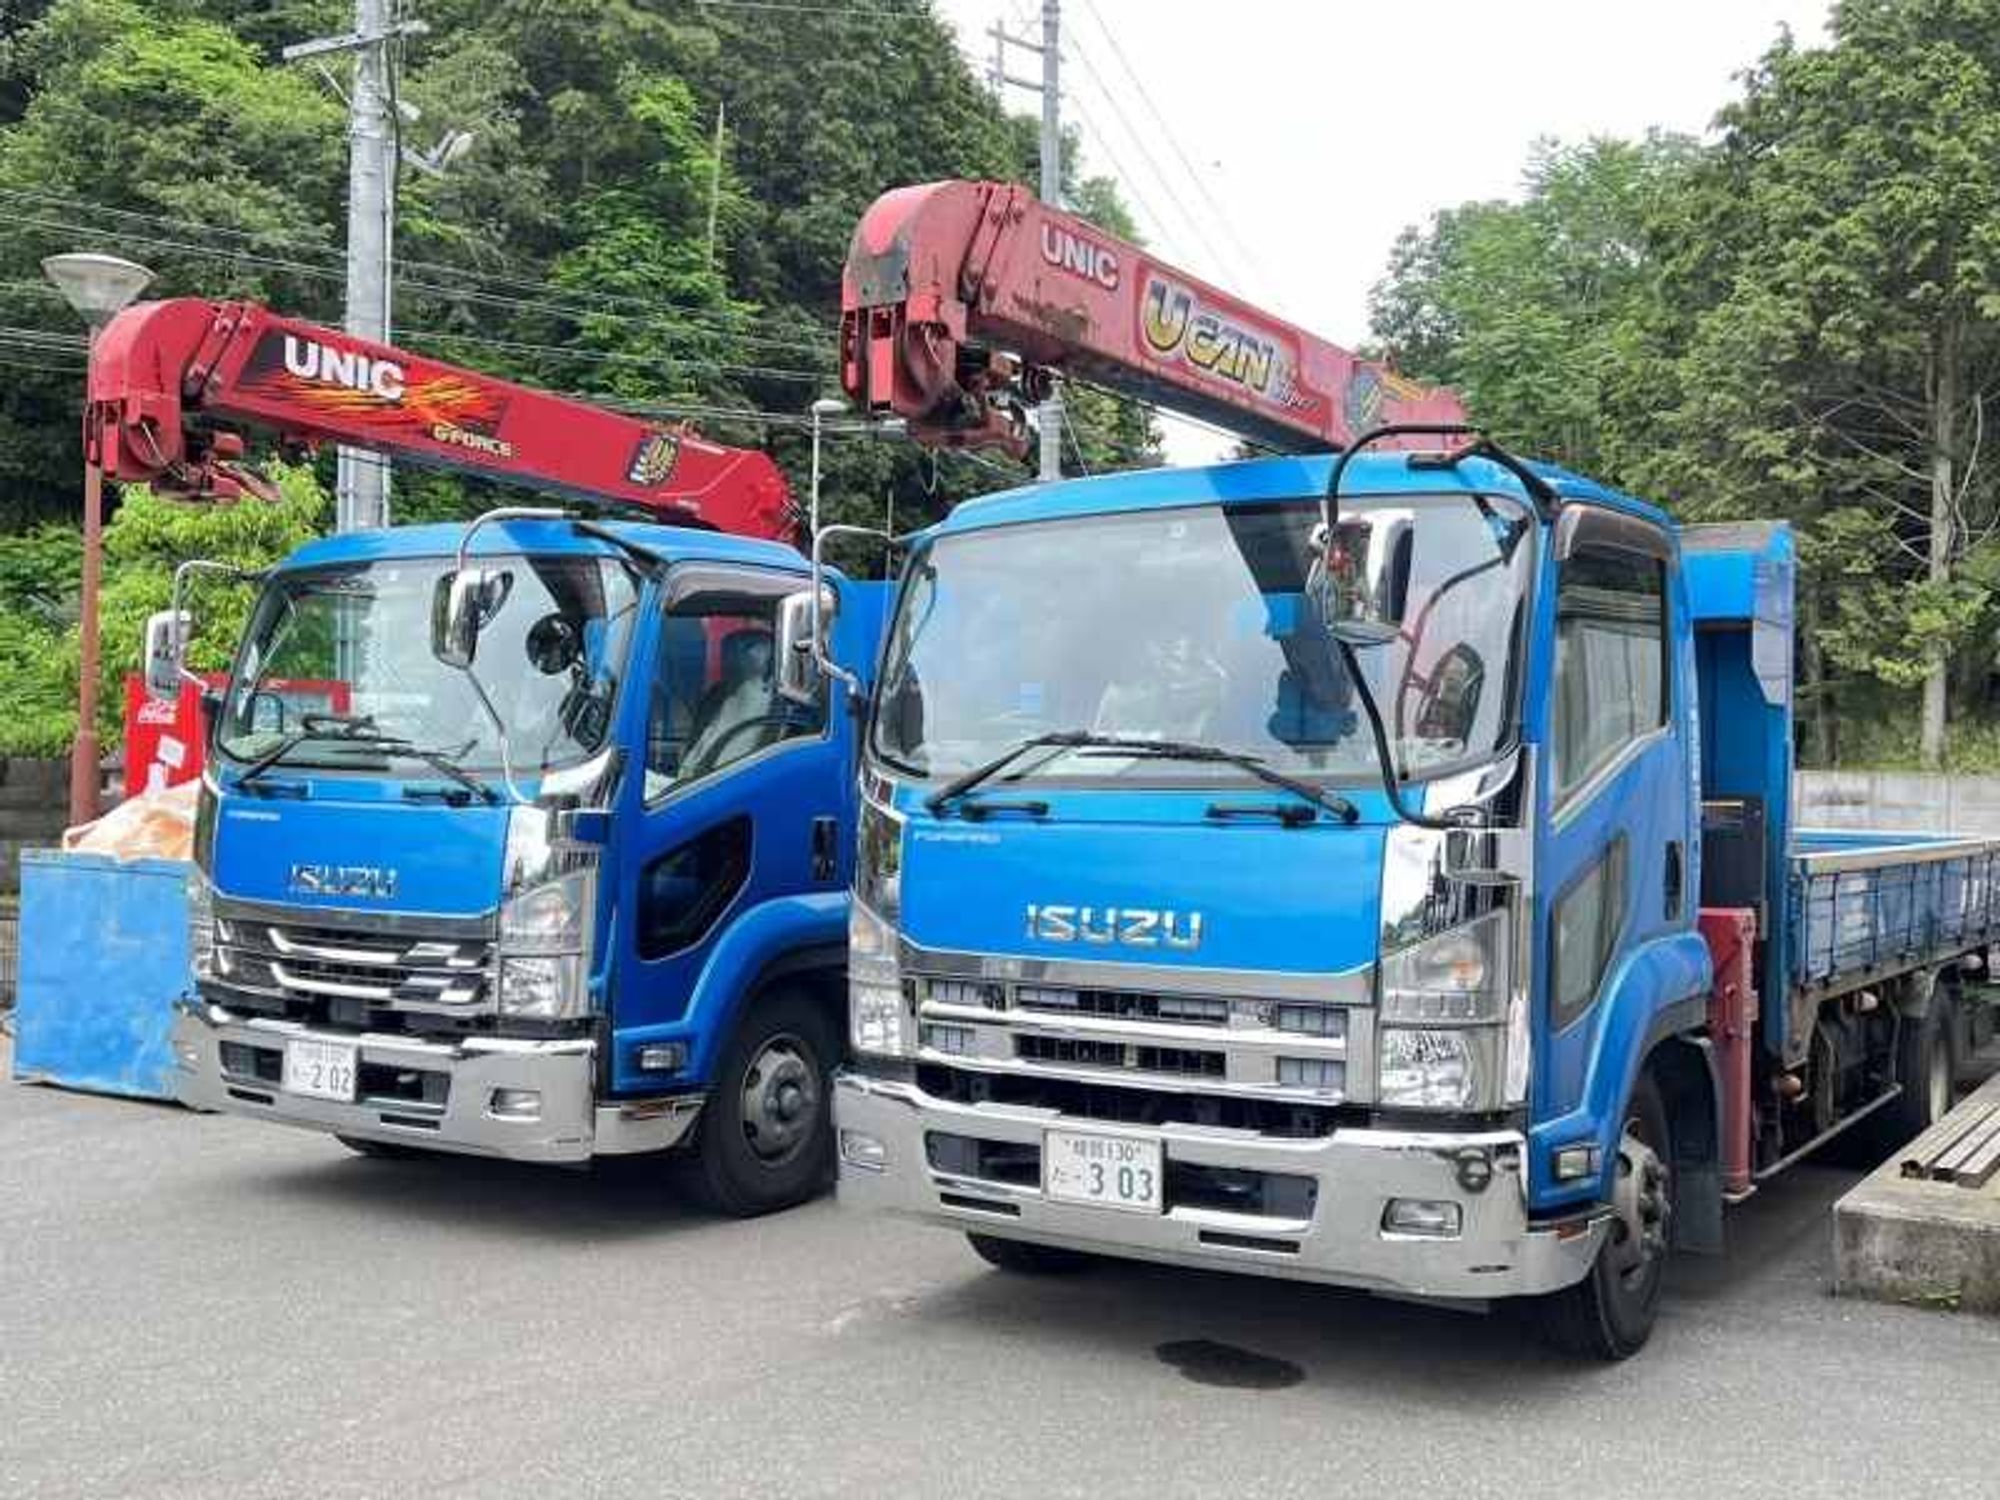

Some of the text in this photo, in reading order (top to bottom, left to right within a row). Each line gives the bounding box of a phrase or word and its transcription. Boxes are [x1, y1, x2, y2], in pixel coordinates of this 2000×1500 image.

[1041, 223, 1118, 290] UNIC
[284, 335, 405, 401] UNIC
[1025, 903, 1201, 948] ISUZU
